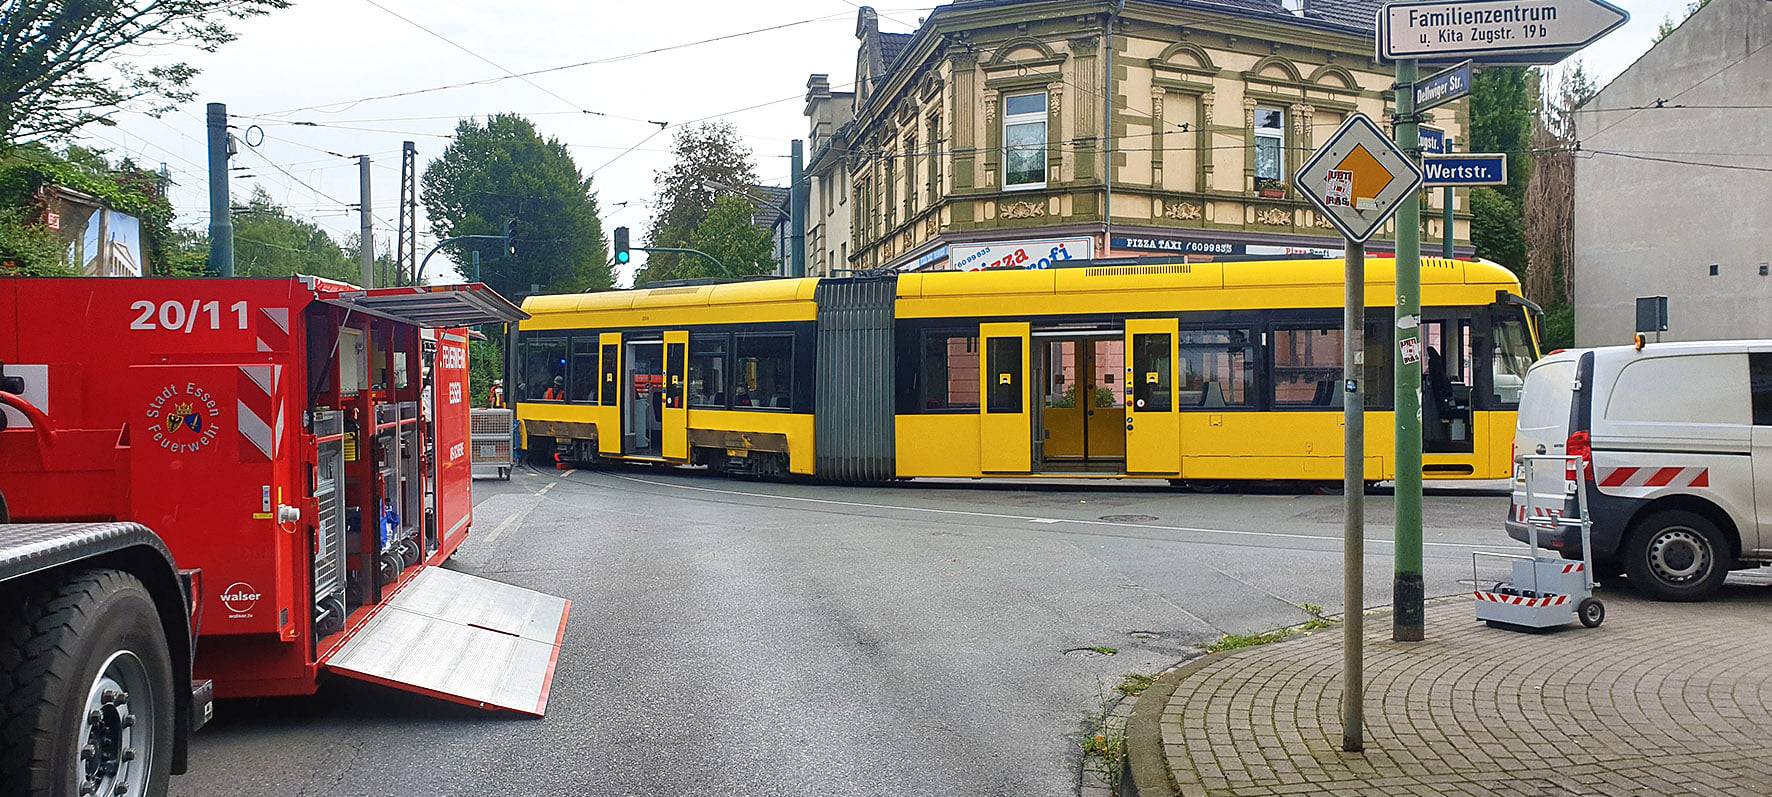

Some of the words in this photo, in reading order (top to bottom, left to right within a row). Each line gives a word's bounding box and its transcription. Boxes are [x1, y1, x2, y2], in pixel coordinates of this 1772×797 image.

[1409, 5, 1557, 27] Familienzentrum
[1420, 33, 1431, 43] u.
[1438, 29, 1463, 43] Kita
[1471, 27, 1515, 43] Zugstr.
[1417, 82, 1448, 104] Dellwiger
[1449, 75, 1463, 90] Str.
[1425, 163, 1491, 179] Wertstr.
[1126, 238, 1156, 249] PIZZA
[1158, 240, 1182, 250] TAXI
[1024, 243, 1072, 271] rofi
[130, 299, 248, 334] 20/11
[146, 383, 178, 418] Stadt
[186, 382, 219, 417] Essen
[148, 422, 219, 453] Feuerwehr
[220, 590, 261, 601] walser
